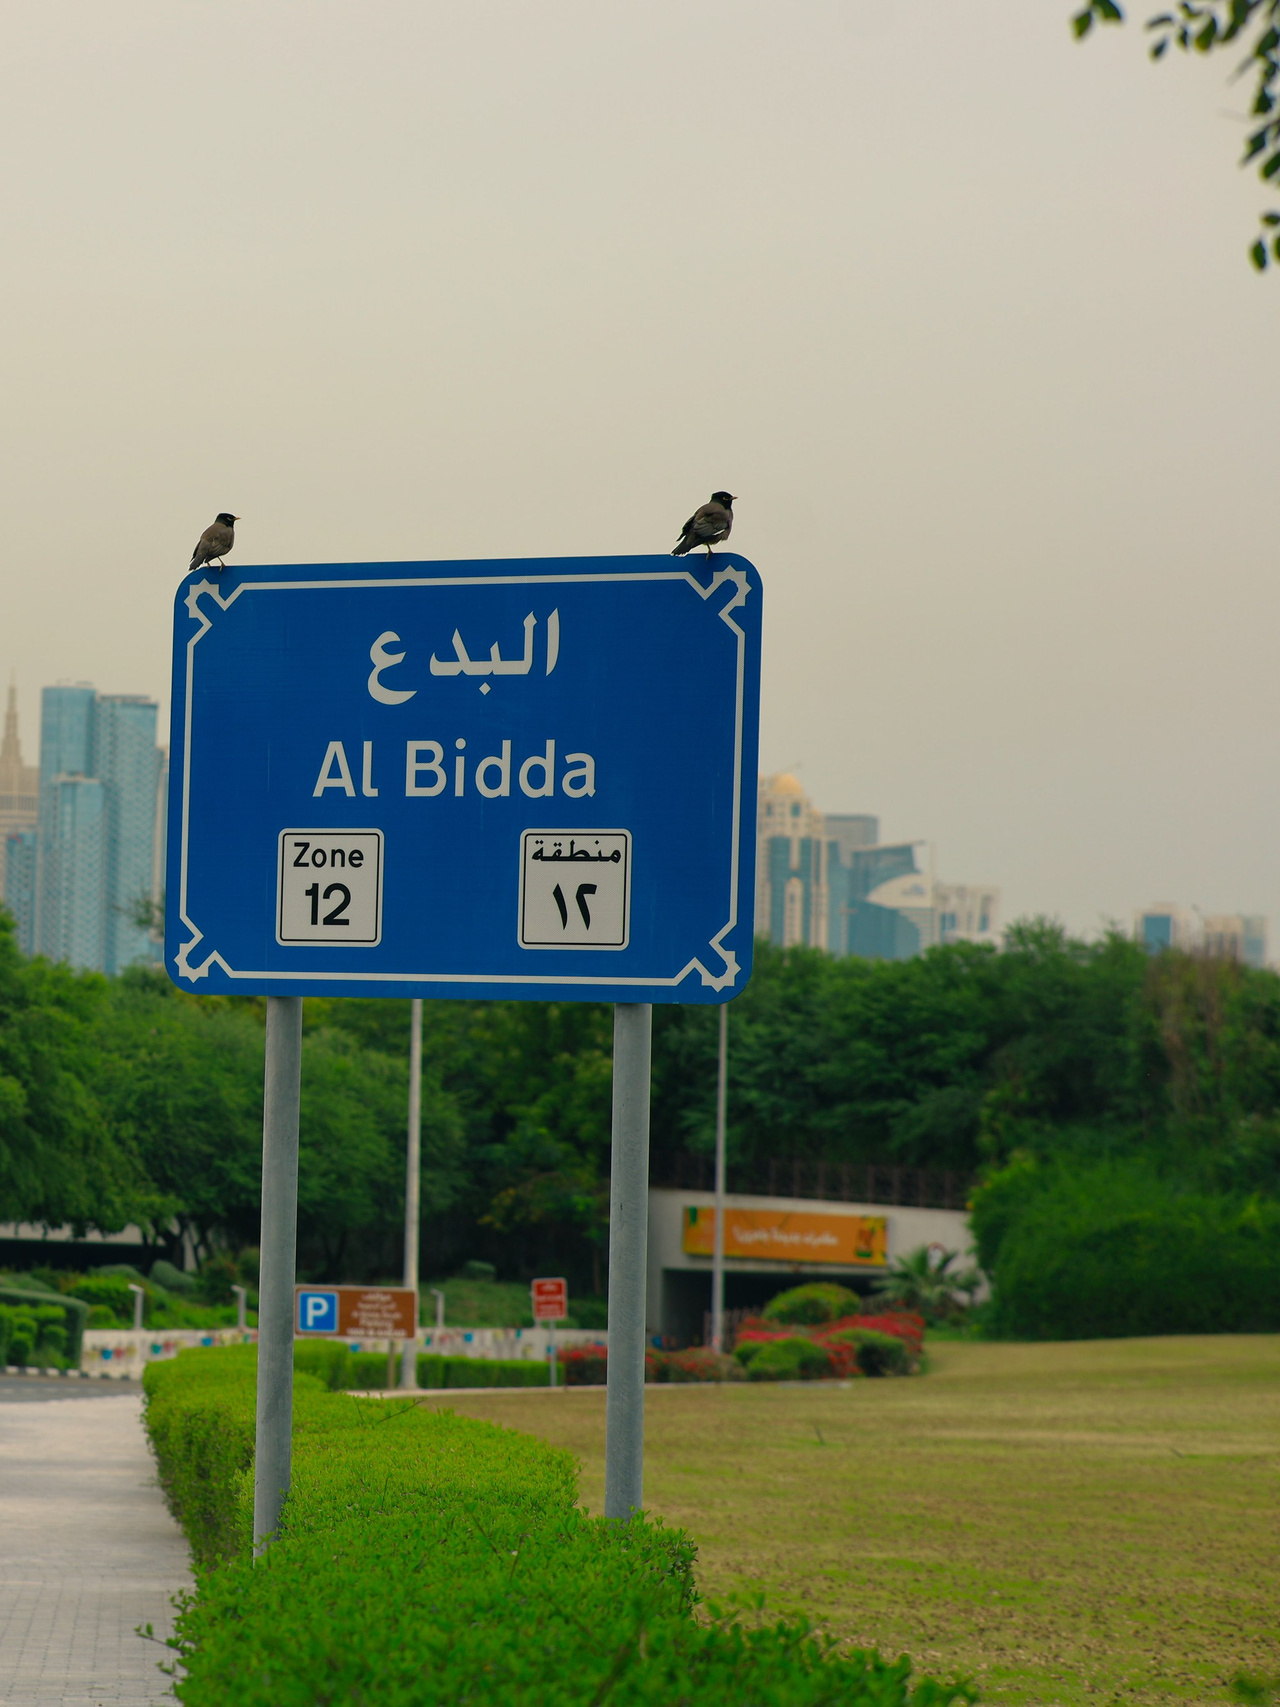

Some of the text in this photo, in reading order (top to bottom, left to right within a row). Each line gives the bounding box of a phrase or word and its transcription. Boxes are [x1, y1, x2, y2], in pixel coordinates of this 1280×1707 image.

[368, 608, 559, 704] البدع
[313, 738, 595, 798] Al Bidda
[293, 842, 364, 868] Zone
[532, 839, 622, 863] منطقة
[305, 883, 351, 925] 12
[553, 883, 597, 930] ١٢
[307, 1297, 328, 1327] P
